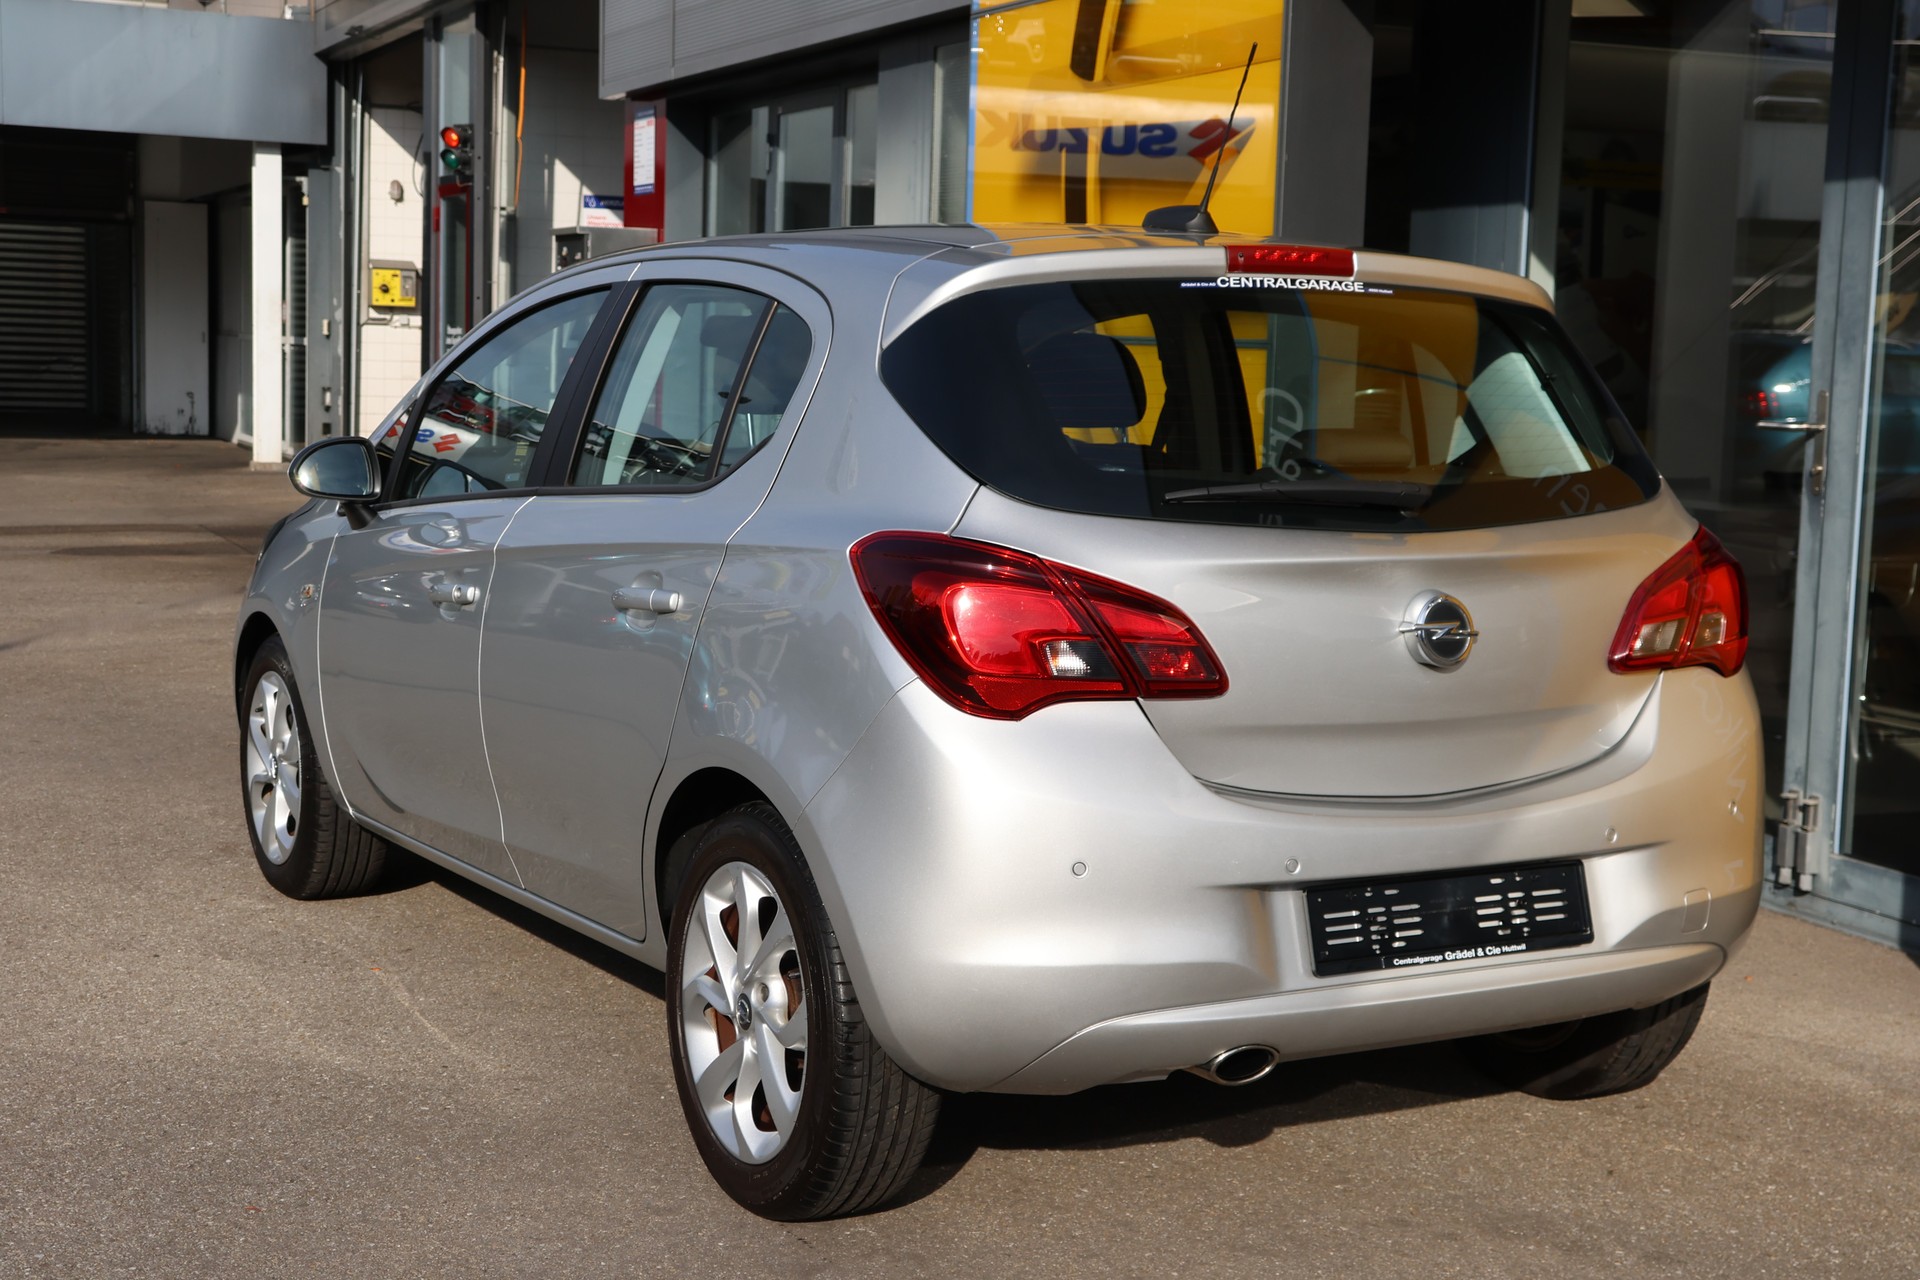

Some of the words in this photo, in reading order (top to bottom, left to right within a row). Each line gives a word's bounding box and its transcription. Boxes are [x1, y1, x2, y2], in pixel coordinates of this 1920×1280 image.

[1216, 276, 1365, 293] CENTRALGARAGE
[1393, 955, 1443, 966] Centralgarage
[1444, 948, 1476, 961] Grädel
[1477, 947, 1484, 957] &
[1485, 945, 1502, 956] Cie
[1502, 943, 1527, 953] Huttwil
